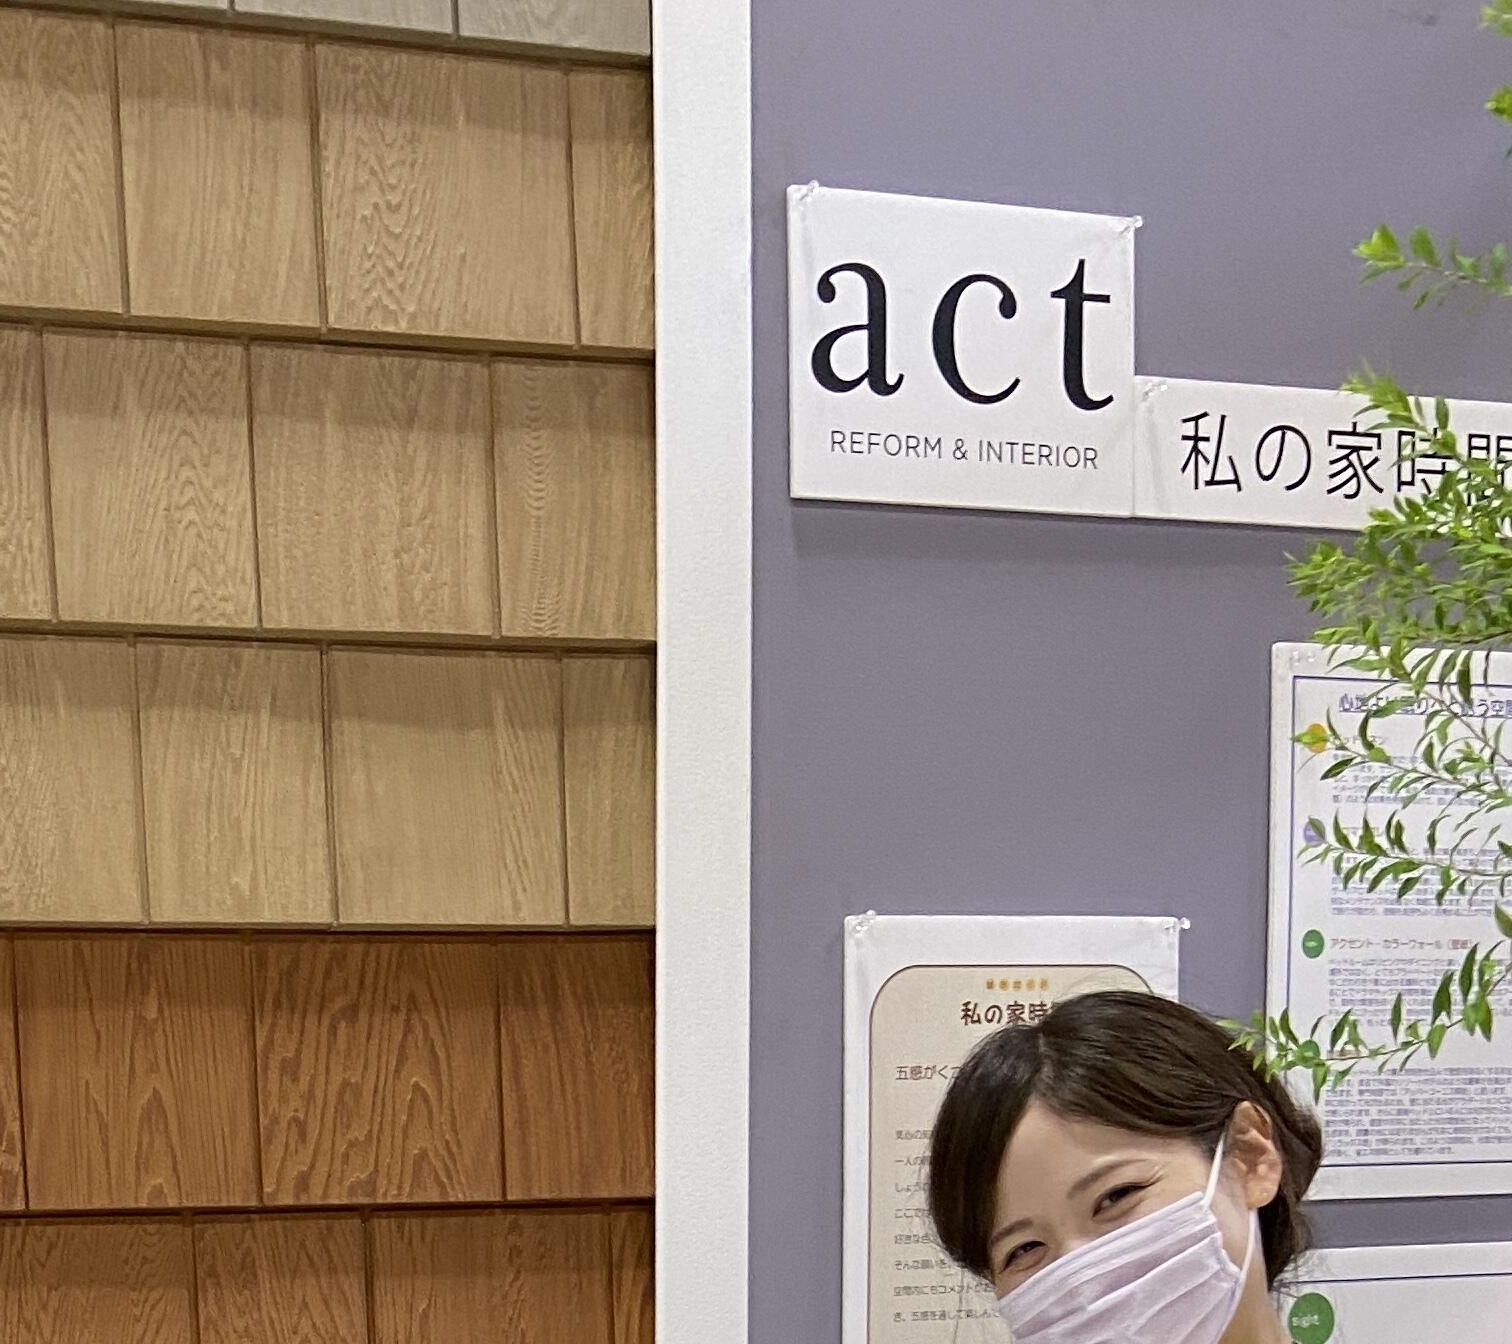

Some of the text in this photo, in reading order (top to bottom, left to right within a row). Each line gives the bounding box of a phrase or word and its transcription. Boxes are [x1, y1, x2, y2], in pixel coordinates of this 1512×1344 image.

[811, 258, 1114, 411] act
[830, 430, 1099, 470] REFORM & INTERIOR
[960, 1000, 1050, 1026] 私の家時
